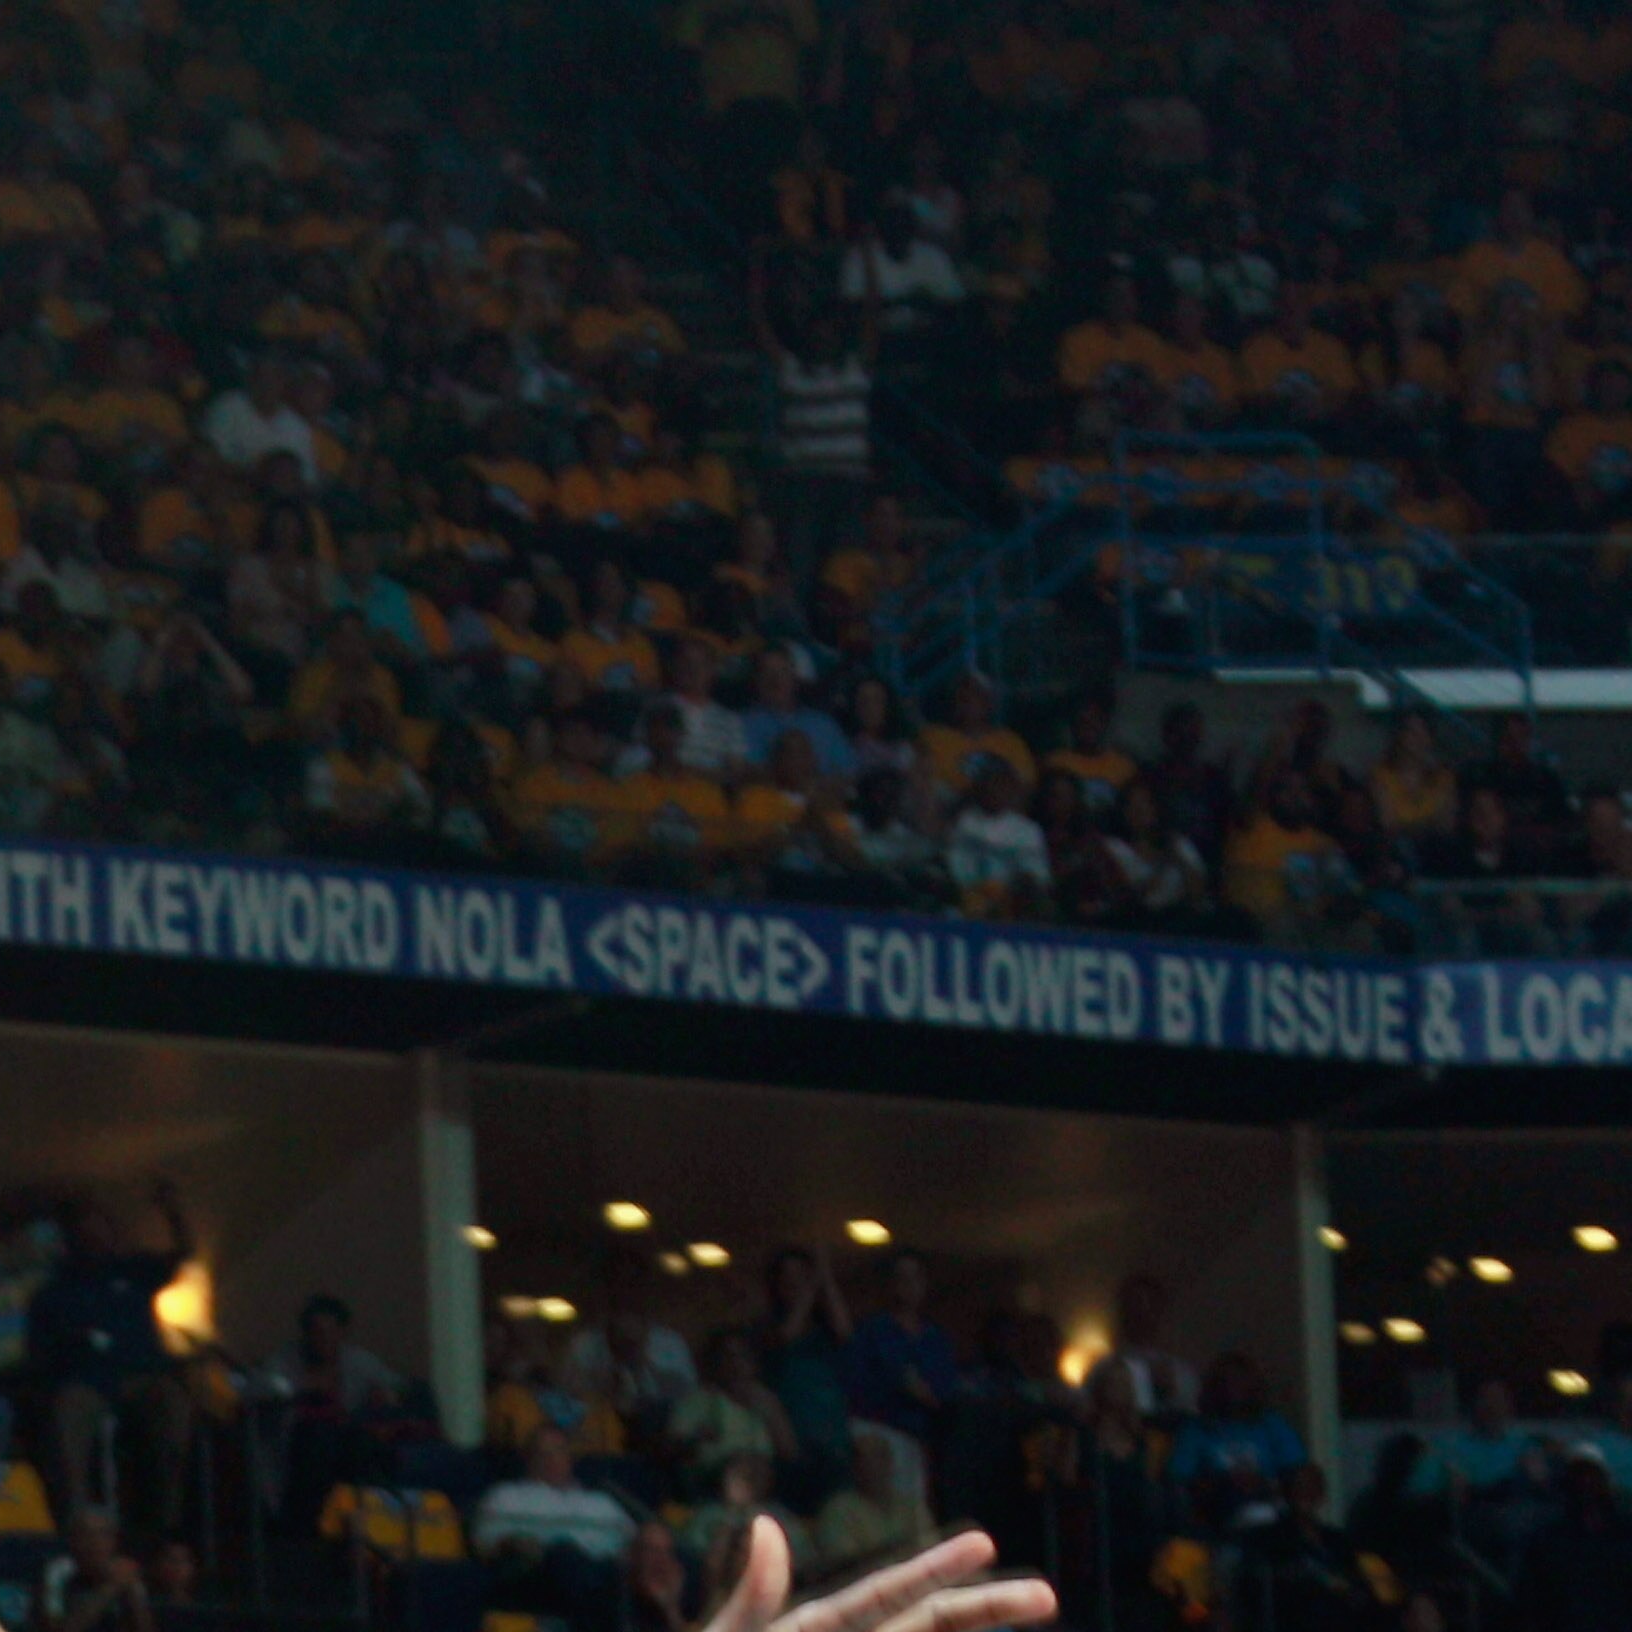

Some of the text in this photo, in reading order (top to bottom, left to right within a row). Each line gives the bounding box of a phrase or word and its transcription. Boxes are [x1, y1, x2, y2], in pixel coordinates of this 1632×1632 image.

[110, 858, 401, 974] KEYWORD
[417, 887, 572, 986] NOLA
[586, 904, 830, 1006] <SPACE>
[844, 925, 1140, 1041] FOLLOWED
[1157, 953, 1235, 1048] BY
[1248, 960, 1413, 1064] ISSUE
[1420, 968, 1464, 1062] &
